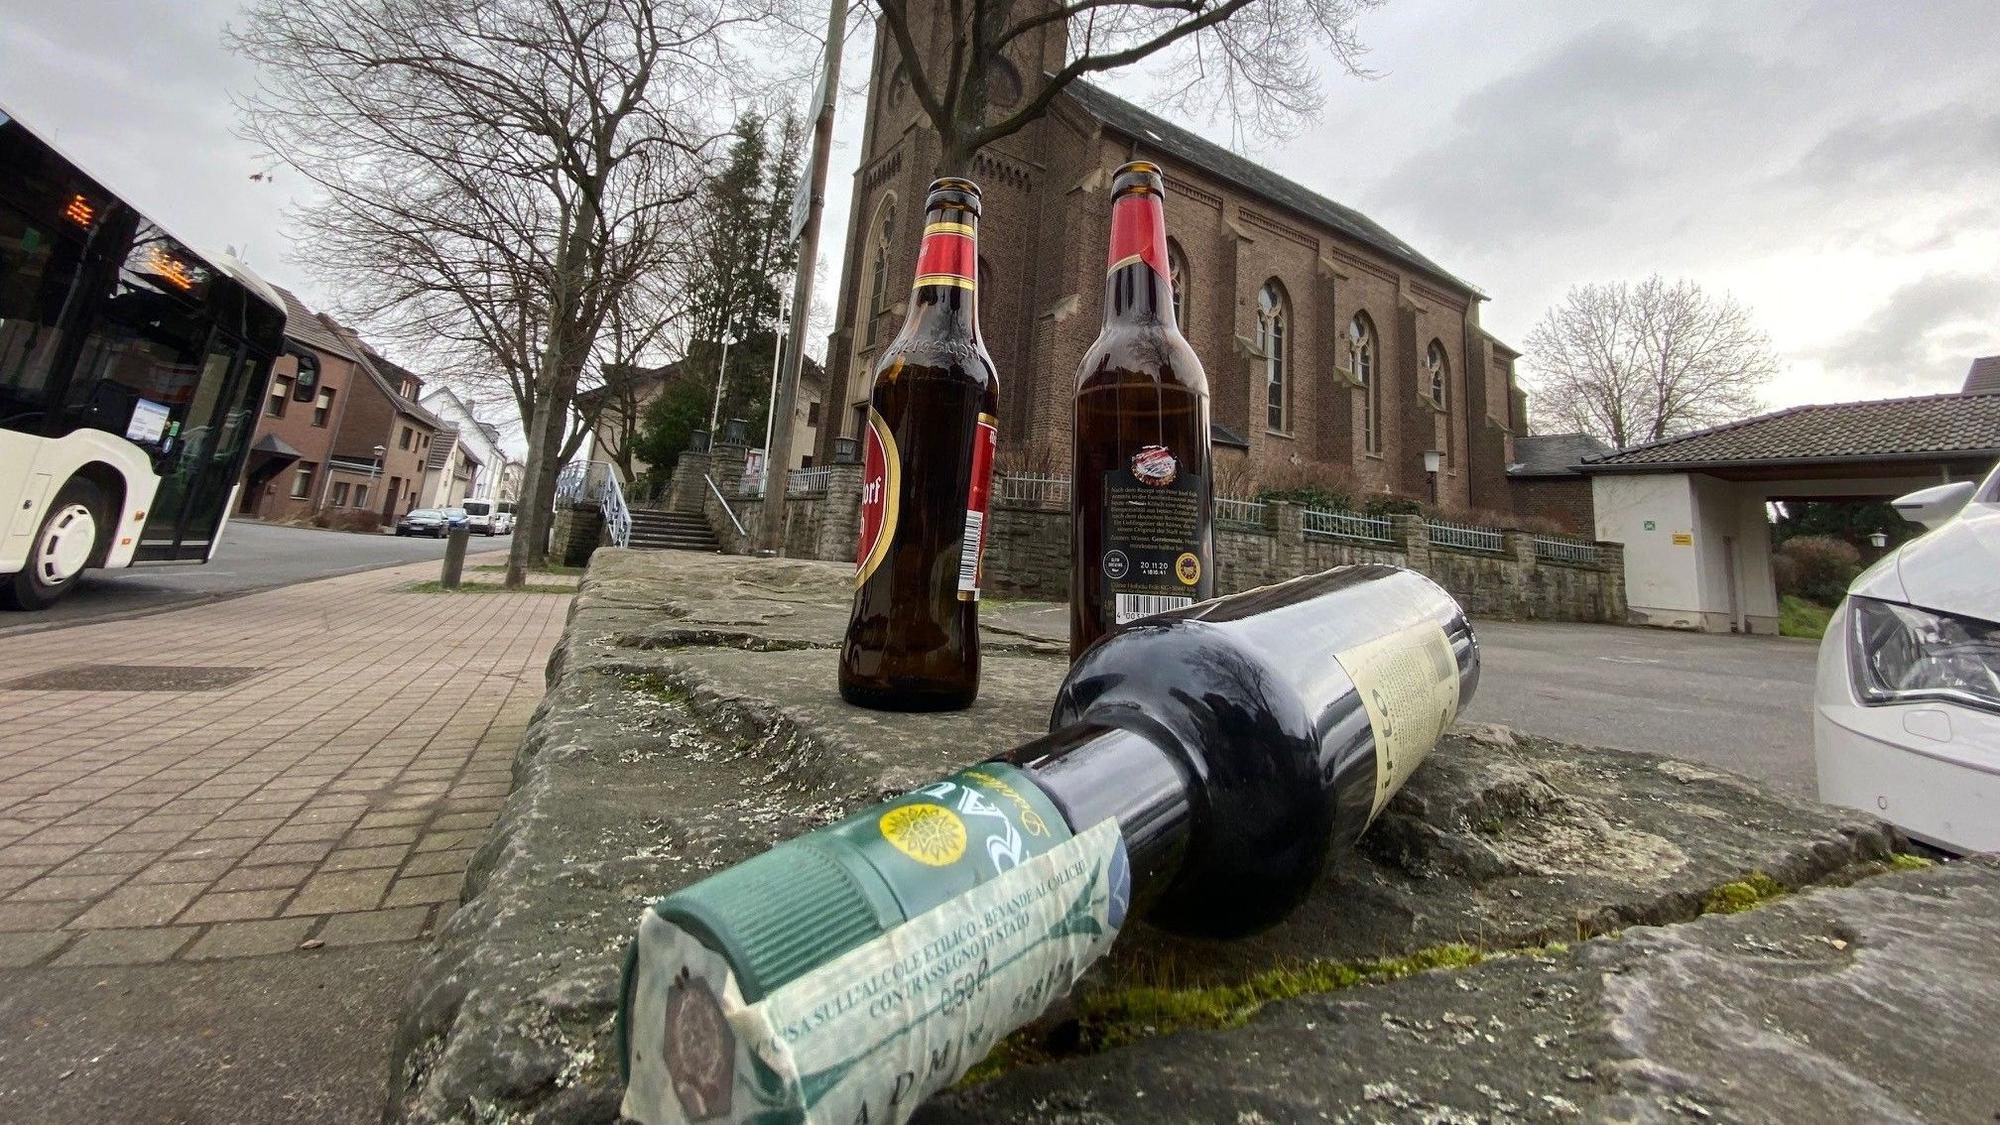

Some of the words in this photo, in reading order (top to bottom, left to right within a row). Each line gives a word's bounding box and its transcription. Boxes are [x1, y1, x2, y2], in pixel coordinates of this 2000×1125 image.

[869, 941, 980, 1019] CONTRASSEGNO
[998, 911, 1031, 942] STATO
[923, 919, 977, 965] ETILICO
[984, 887, 1033, 929] BEVANDE
